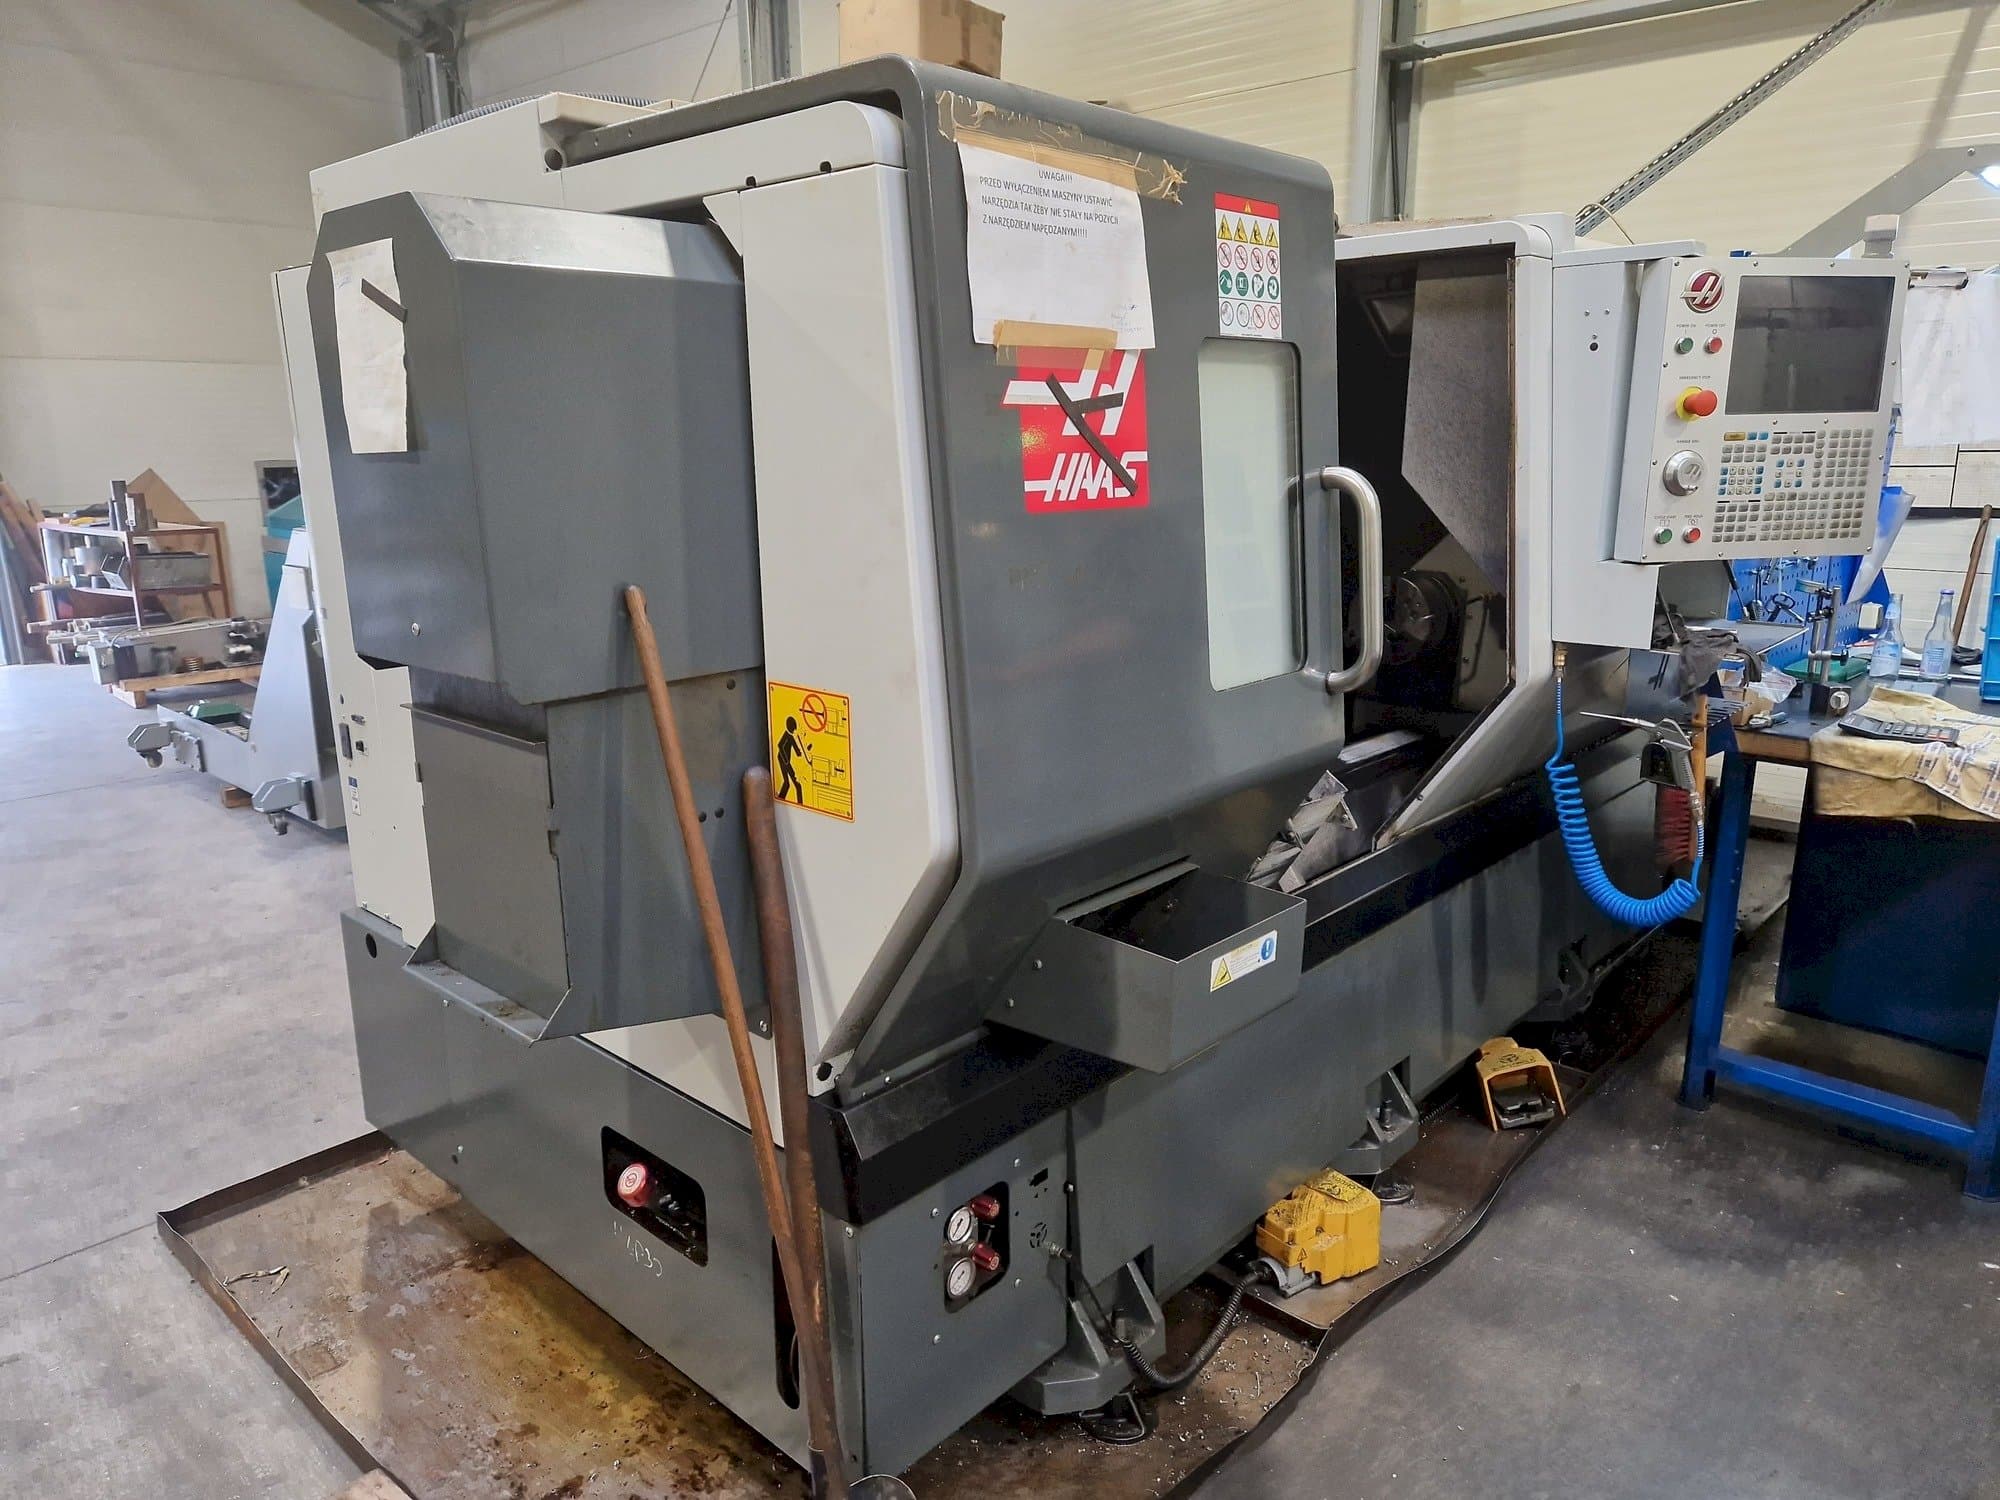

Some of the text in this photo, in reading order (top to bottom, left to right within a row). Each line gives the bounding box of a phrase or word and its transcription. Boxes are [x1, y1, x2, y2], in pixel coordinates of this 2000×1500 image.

[1038, 170, 1073, 182] UWAGA!!!
[979, 175, 1002, 189] PRZED
[1051, 190, 1083, 202] MASZYNY
[982, 214, 988, 224] Z
[1020, 202, 1032, 212] TAK
[1050, 207, 1062, 217] NIE
[1083, 212, 1094, 221] NA
[1024, 451, 1148, 502] HAAS
